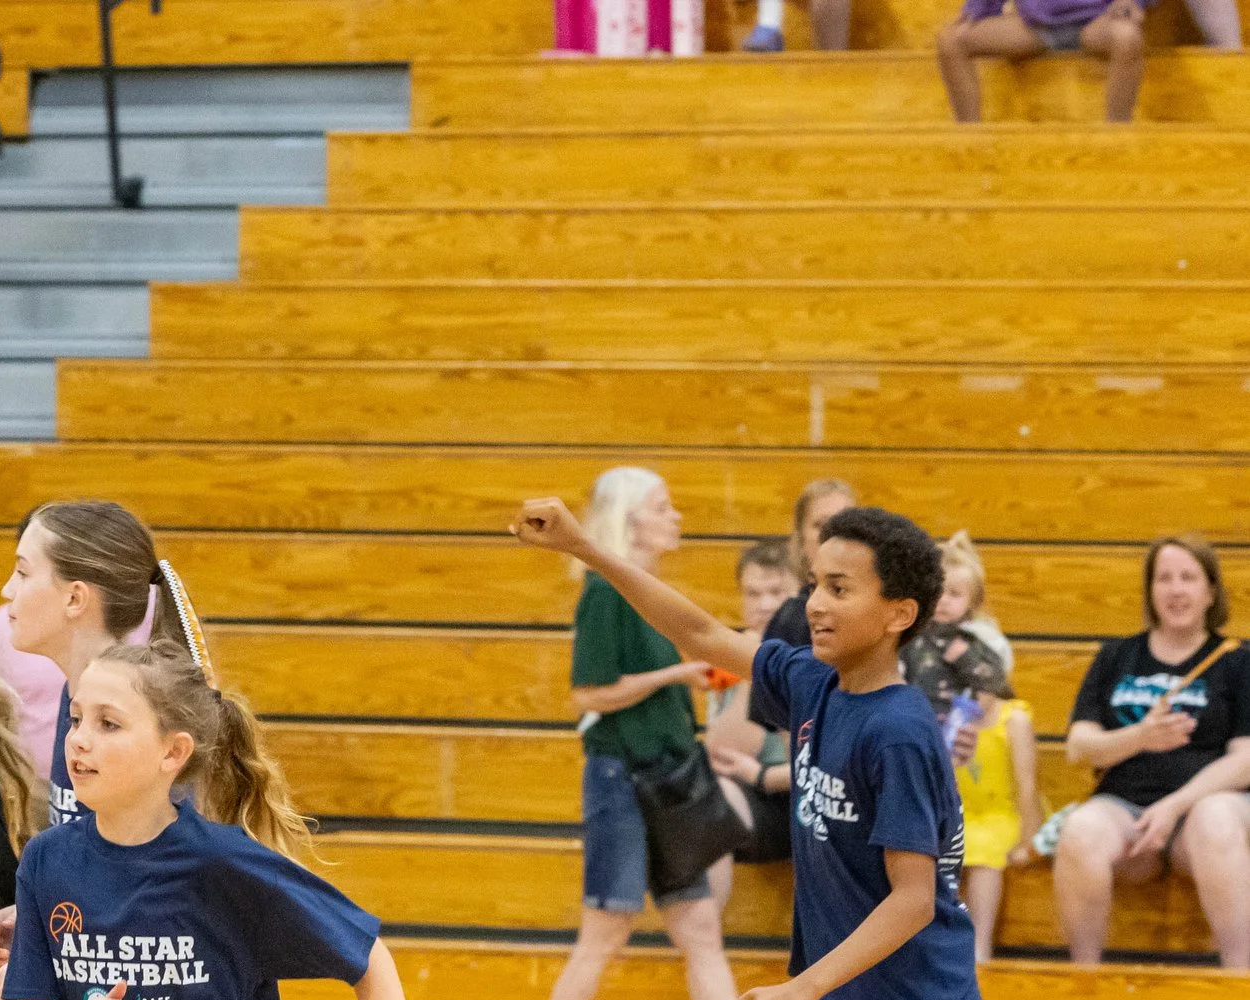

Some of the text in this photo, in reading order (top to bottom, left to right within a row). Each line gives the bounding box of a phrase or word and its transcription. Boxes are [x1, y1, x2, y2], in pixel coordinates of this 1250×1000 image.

[61, 933, 195, 961] ALL STAR
[52, 957, 210, 986] BASKETBALL
